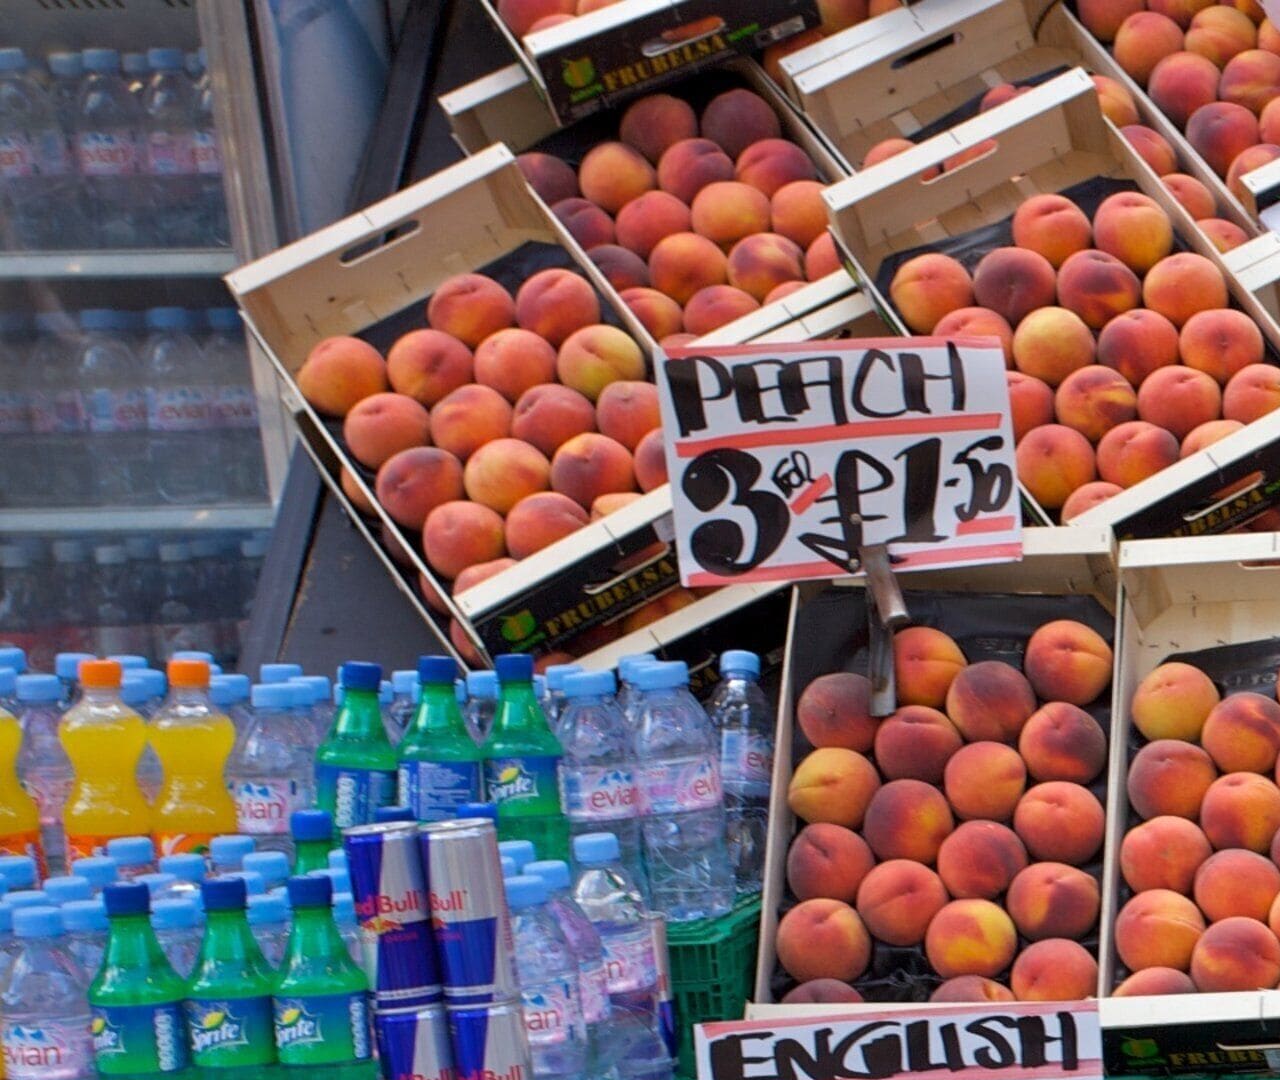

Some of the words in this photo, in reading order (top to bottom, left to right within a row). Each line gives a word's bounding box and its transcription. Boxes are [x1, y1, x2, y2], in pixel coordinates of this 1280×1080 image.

[664, 341, 967, 437] PEACH
[682, 447, 791, 577] 3
[544, 558, 676, 637] FRUBELSA
[376, 890, 417, 914] Bull
